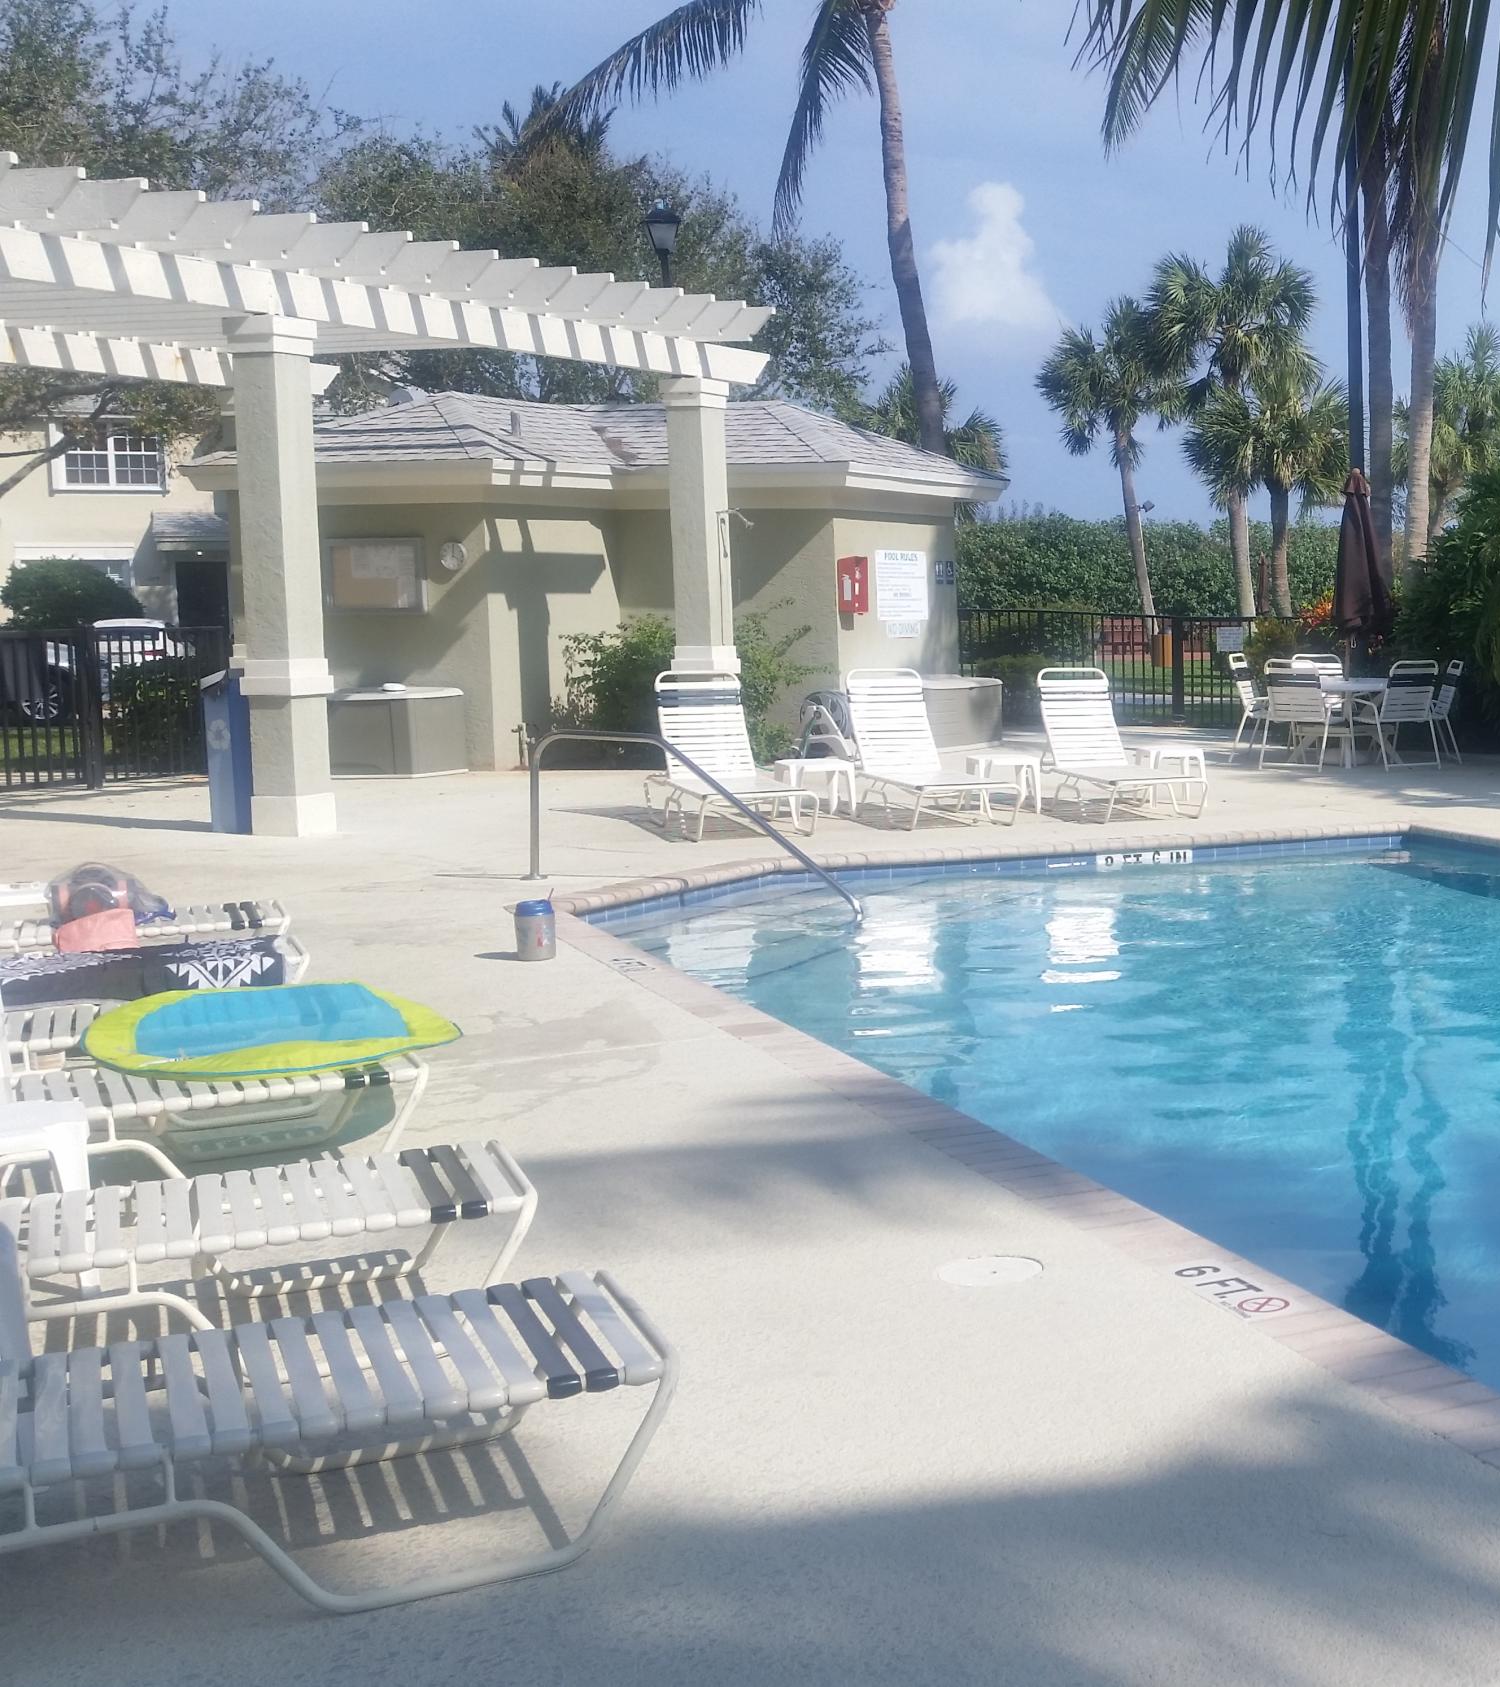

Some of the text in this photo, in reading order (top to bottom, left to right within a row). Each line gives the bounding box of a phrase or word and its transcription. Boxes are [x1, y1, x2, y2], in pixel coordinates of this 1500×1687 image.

[884, 552, 918, 562] POOL RULES
[1174, 1265, 1221, 1278] 6
